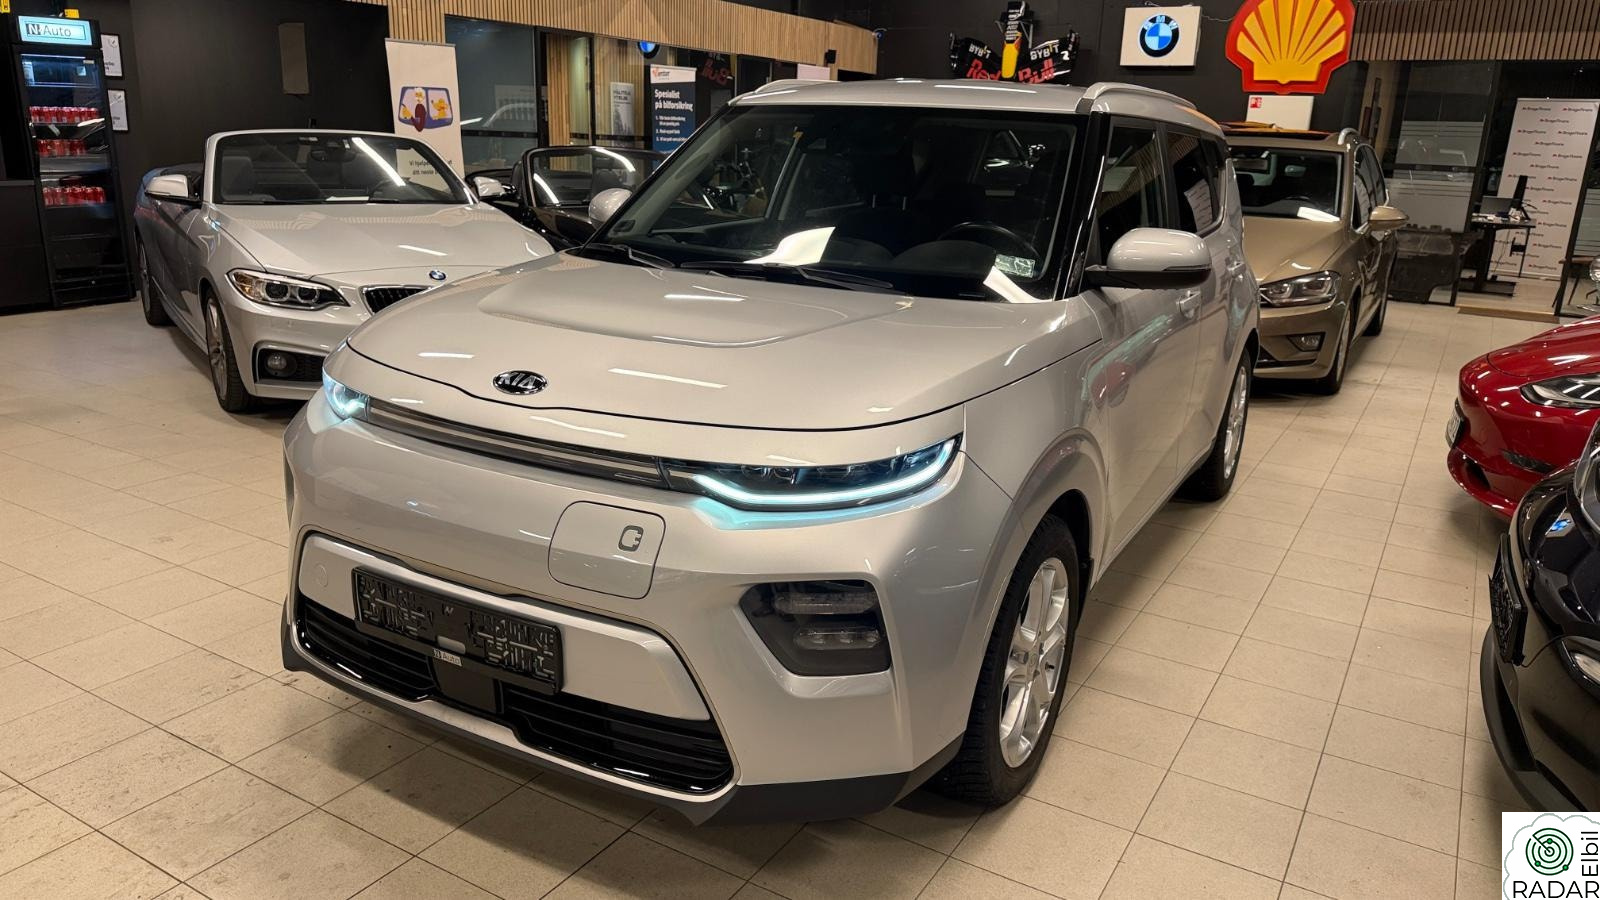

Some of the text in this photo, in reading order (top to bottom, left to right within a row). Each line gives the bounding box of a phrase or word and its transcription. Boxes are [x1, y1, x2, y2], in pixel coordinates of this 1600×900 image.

[1143, 15, 1178, 30] BMW
[42, 25, 72, 37] Auto
[969, 44, 992, 59] BYBIT
[1030, 43, 1060, 61] BYBIT
[966, 58, 1056, 84] Red Bull
[654, 89, 680, 99] Spesialist
[655, 100, 694, 112] på bilforsikring
[498, 372, 536, 389] KIA
